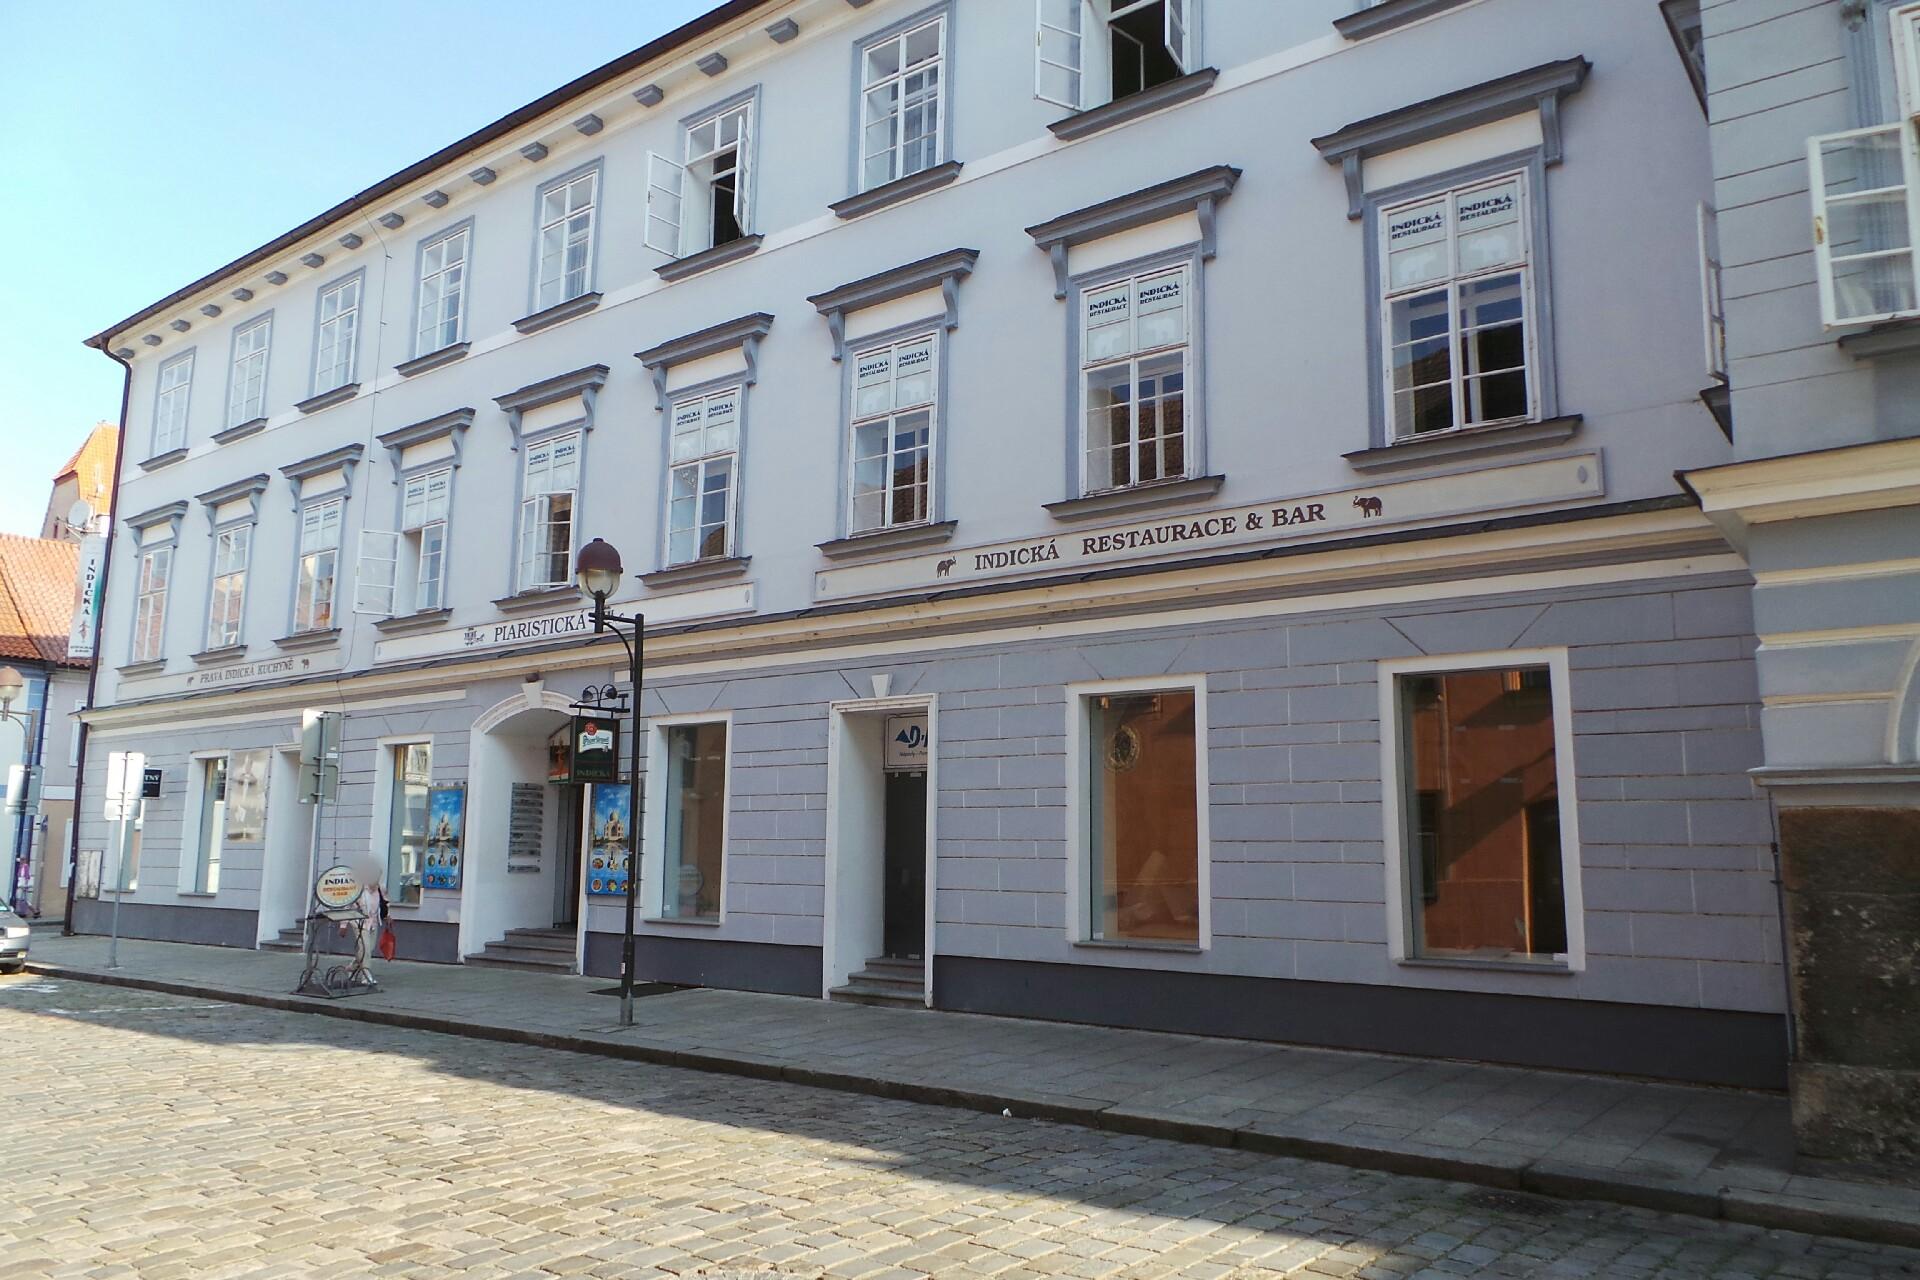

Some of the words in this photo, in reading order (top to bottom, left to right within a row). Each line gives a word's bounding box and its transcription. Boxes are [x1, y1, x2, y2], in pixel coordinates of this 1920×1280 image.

[1460, 193, 1512, 214] INDICKÁ
[1460, 203, 1512, 222] RESTAURACE
[1391, 211, 1441, 232] INDICKÁ
[1391, 221, 1442, 240] RESTAURACE
[1140, 281, 1180, 298] INDICKÁ
[1140, 290, 1180, 305] RESTAURACE
[1089, 294, 1127, 311] INDICKÁ
[974, 538, 1060, 571] INDICKÁ
[1081, 517, 1237, 556] RESTAURACE
[1245, 512, 1264, 531] &
[1272, 503, 1327, 527] BAR
[494, 609, 587, 643] PIARISTICKÁ
